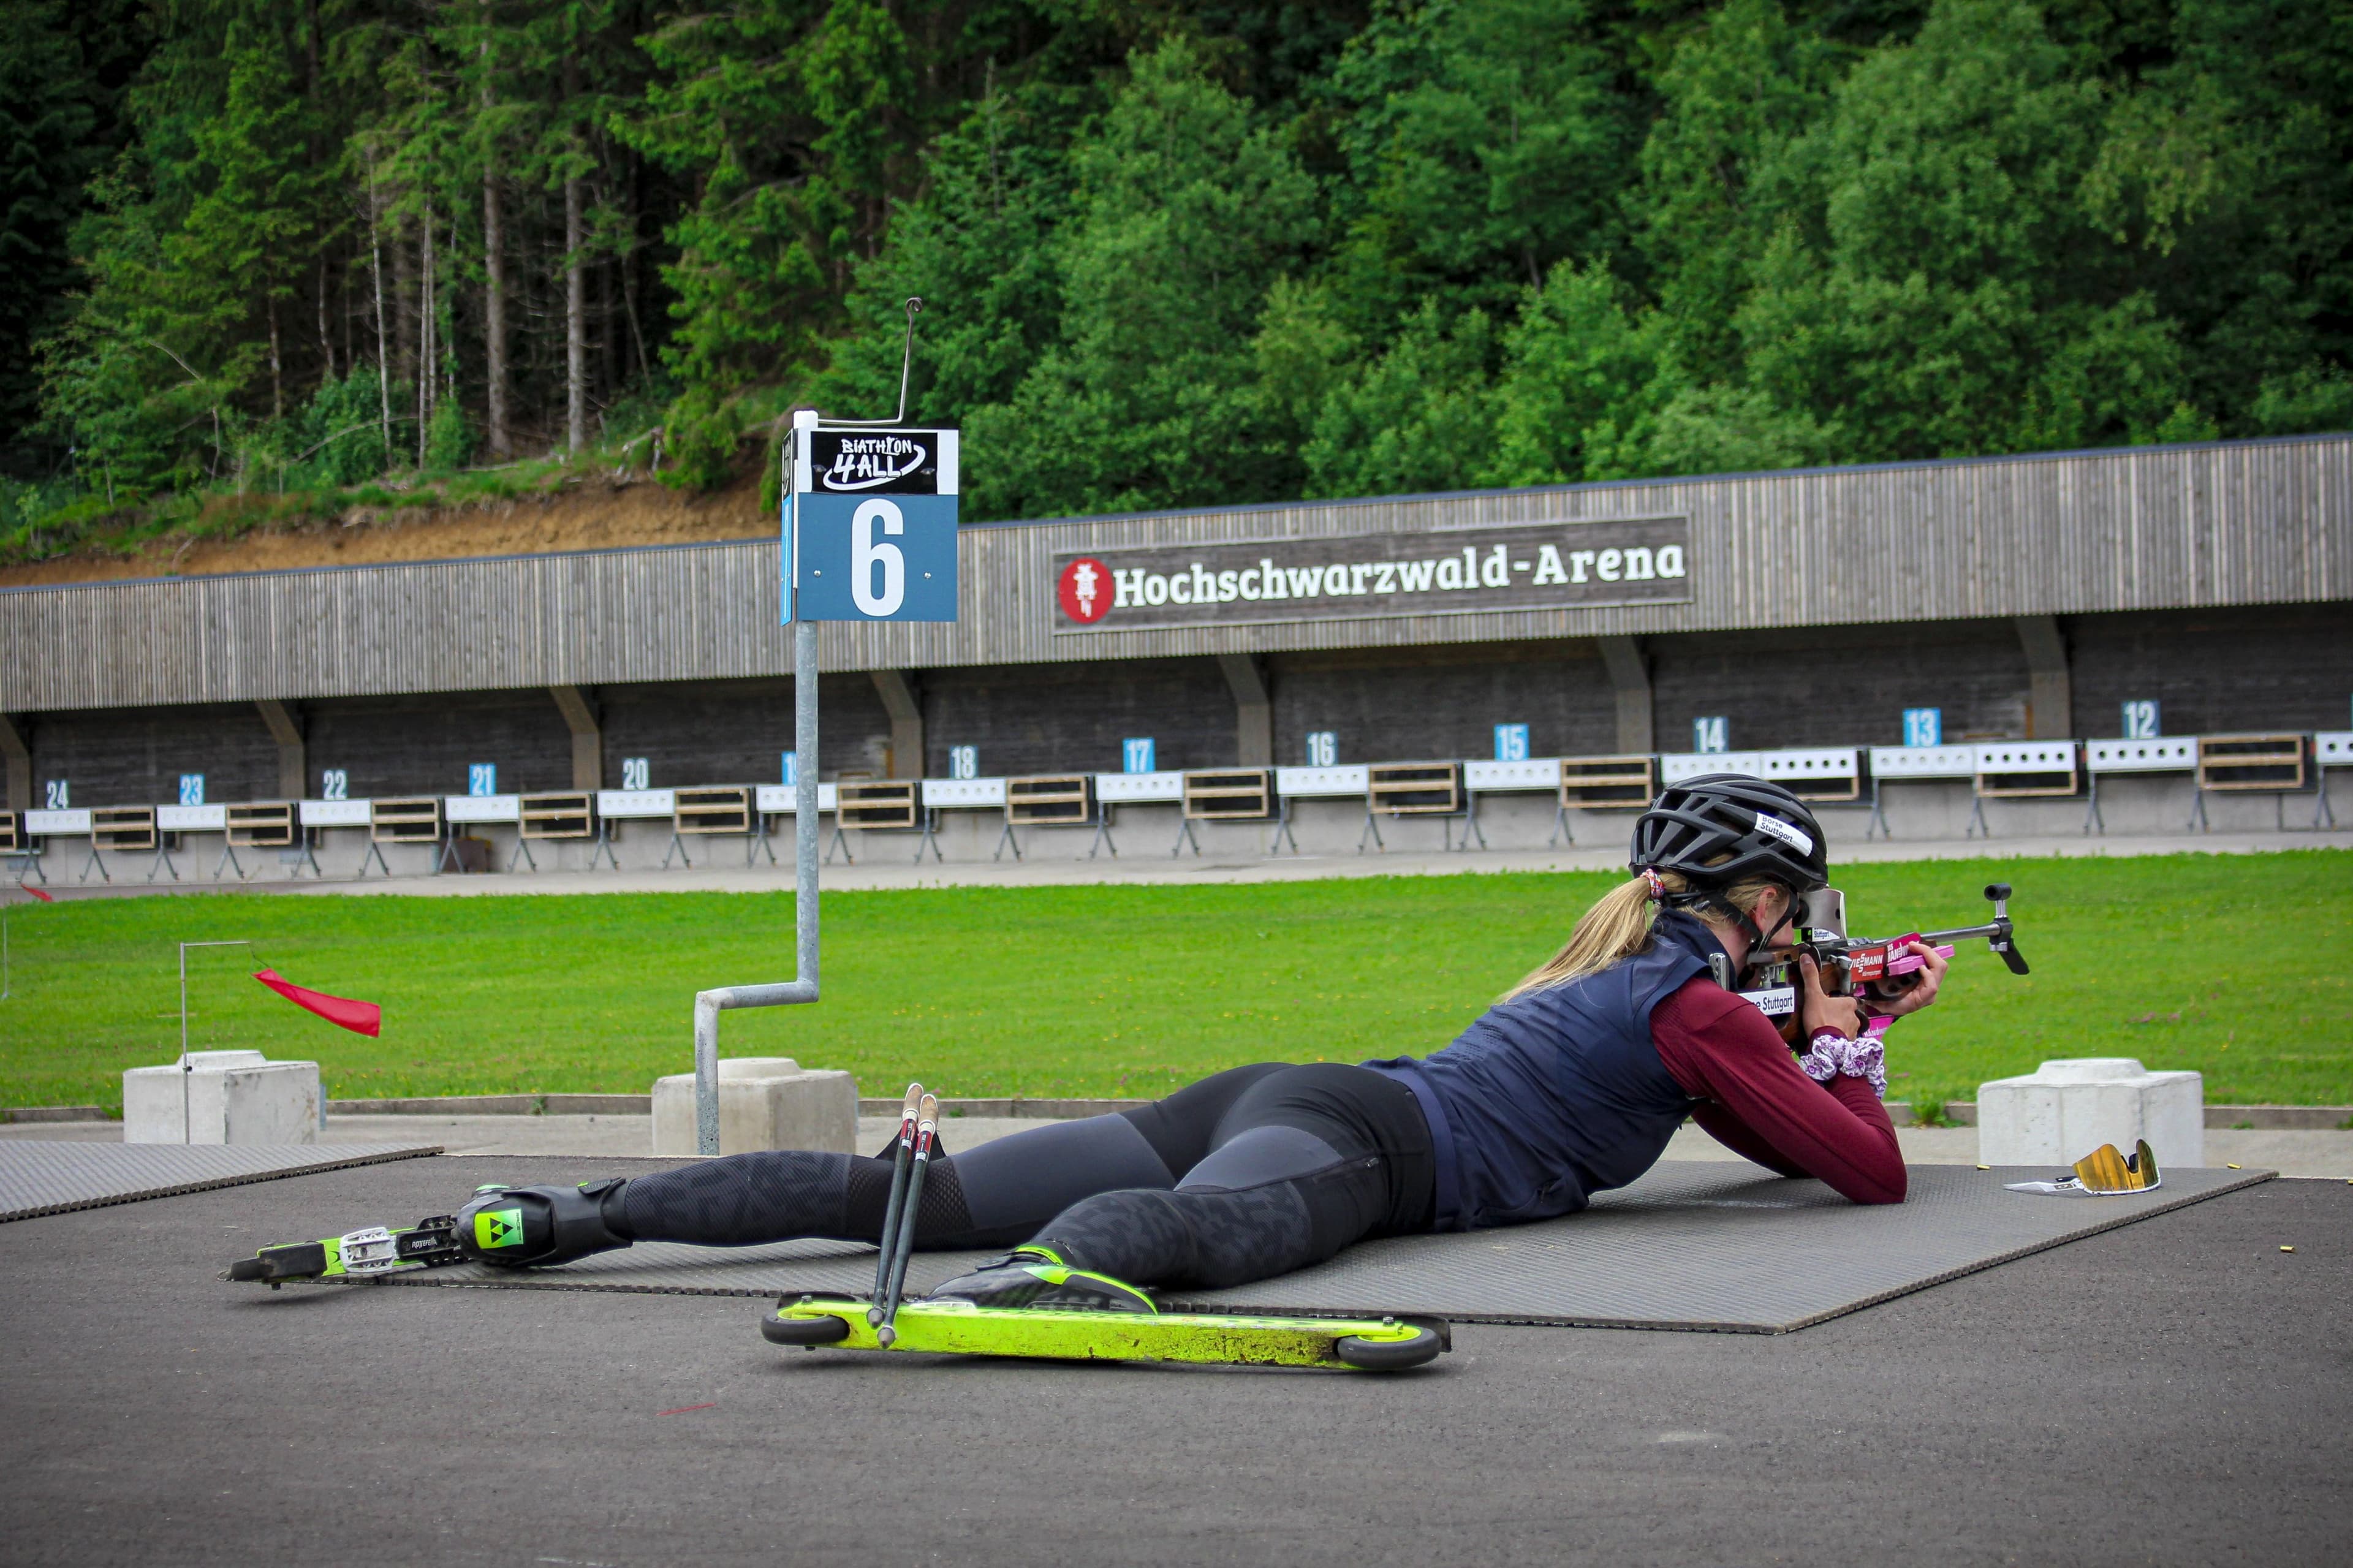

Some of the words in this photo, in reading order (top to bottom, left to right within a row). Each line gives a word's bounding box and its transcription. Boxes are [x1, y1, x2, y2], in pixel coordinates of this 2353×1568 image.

[852, 498, 905, 616] 6
[1113, 543, 1686, 607] Hochschwarzwald-Arena
[1696, 716, 1726, 754] 14
[1907, 710, 1936, 746] 13
[2124, 700, 2156, 740] 12
[1128, 741, 1150, 773] 17
[1307, 731, 1335, 766] 16
[1497, 726, 1525, 760] 15
[623, 757, 648, 790] 20
[784, 754, 797, 785] 1
[951, 745, 976, 779] 18
[47, 779, 69, 809] 24
[180, 776, 203, 806] 23
[323, 770, 347, 800] 22
[472, 766, 491, 796] 21
[1760, 822, 1793, 843] Stuttgart
[1763, 994, 1793, 1012] Stuttgart
